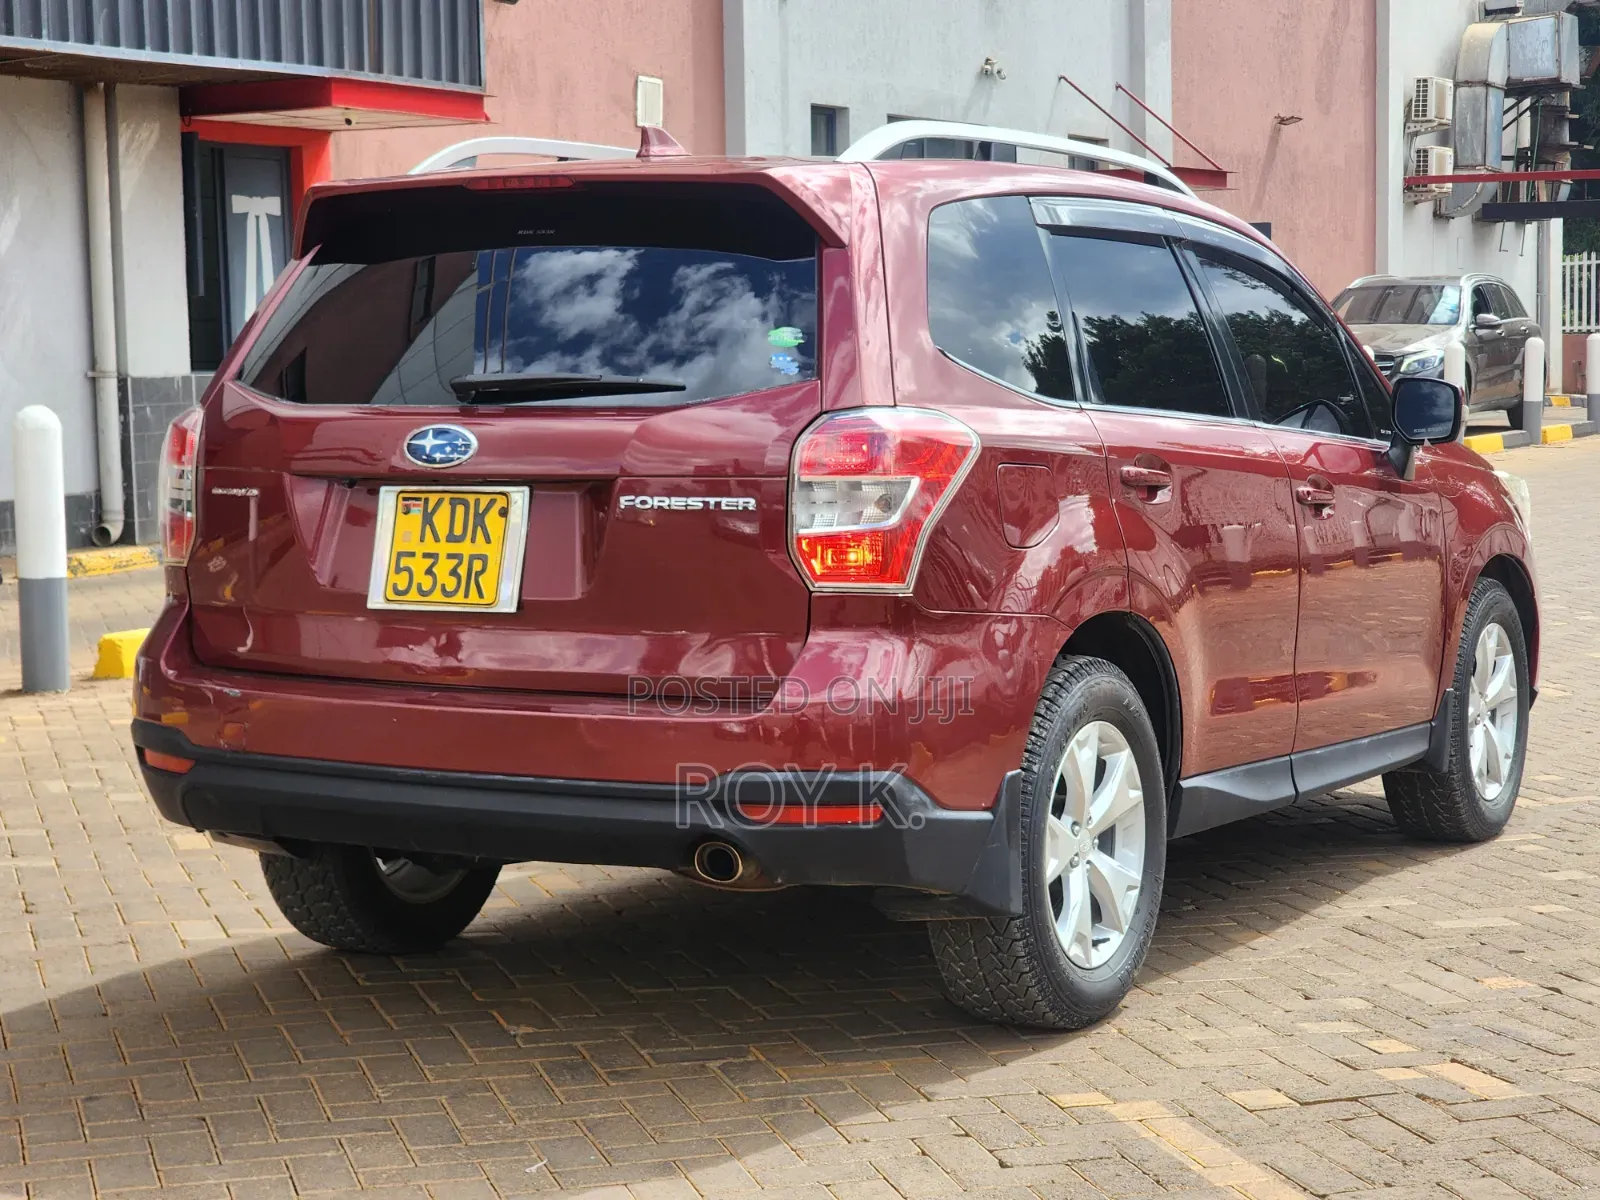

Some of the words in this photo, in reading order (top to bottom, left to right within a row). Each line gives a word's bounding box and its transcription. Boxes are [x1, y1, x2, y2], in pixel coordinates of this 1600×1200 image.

[420, 497, 497, 544] KDK
[619, 495, 757, 511] FORESTER
[392, 551, 489, 599] 533R
